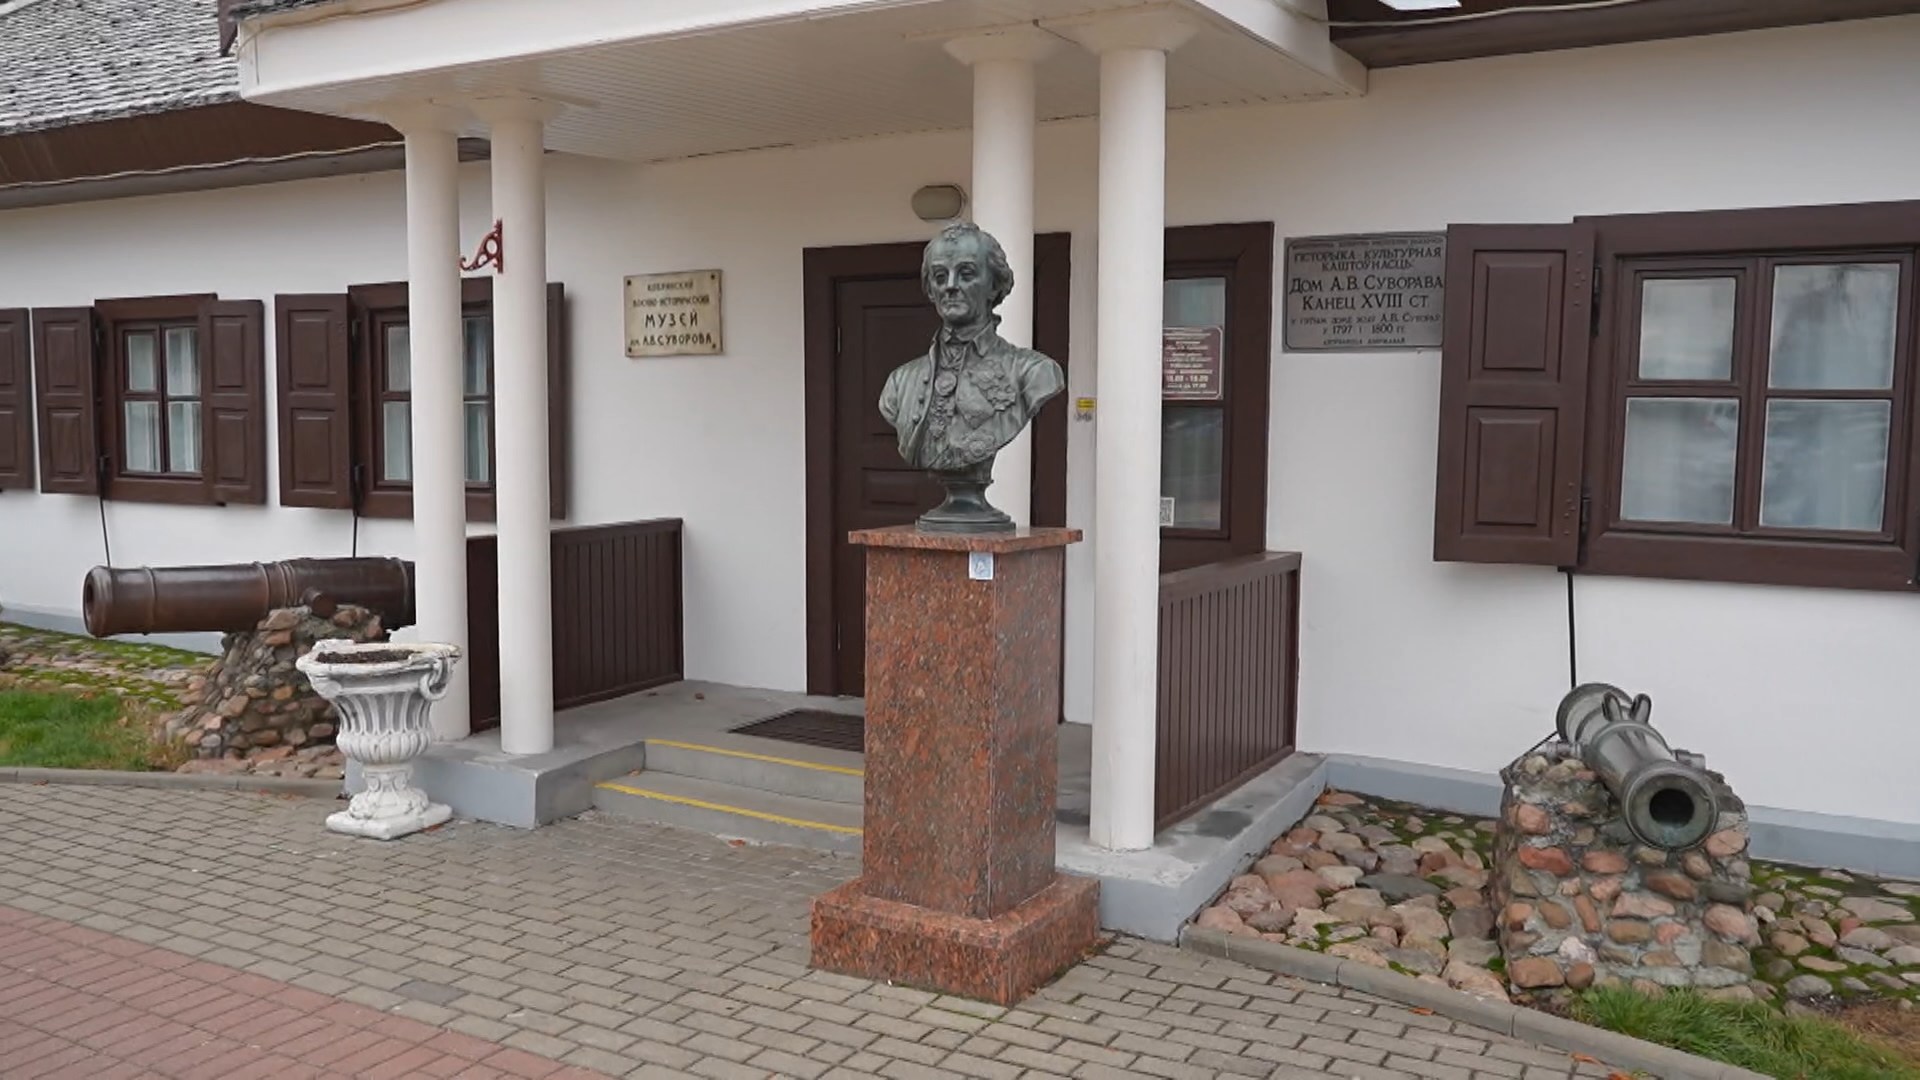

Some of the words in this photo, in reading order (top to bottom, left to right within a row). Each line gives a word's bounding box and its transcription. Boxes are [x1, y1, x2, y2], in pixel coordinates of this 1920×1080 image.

[1364, 275, 1444, 290] СУВОРАВА
[1302, 295, 1356, 311] КАНЕЦ
[1361, 293, 1403, 309] XVIII
[645, 309, 698, 328] МУЗЕЙ
[1332, 324, 1353, 335] 1797
